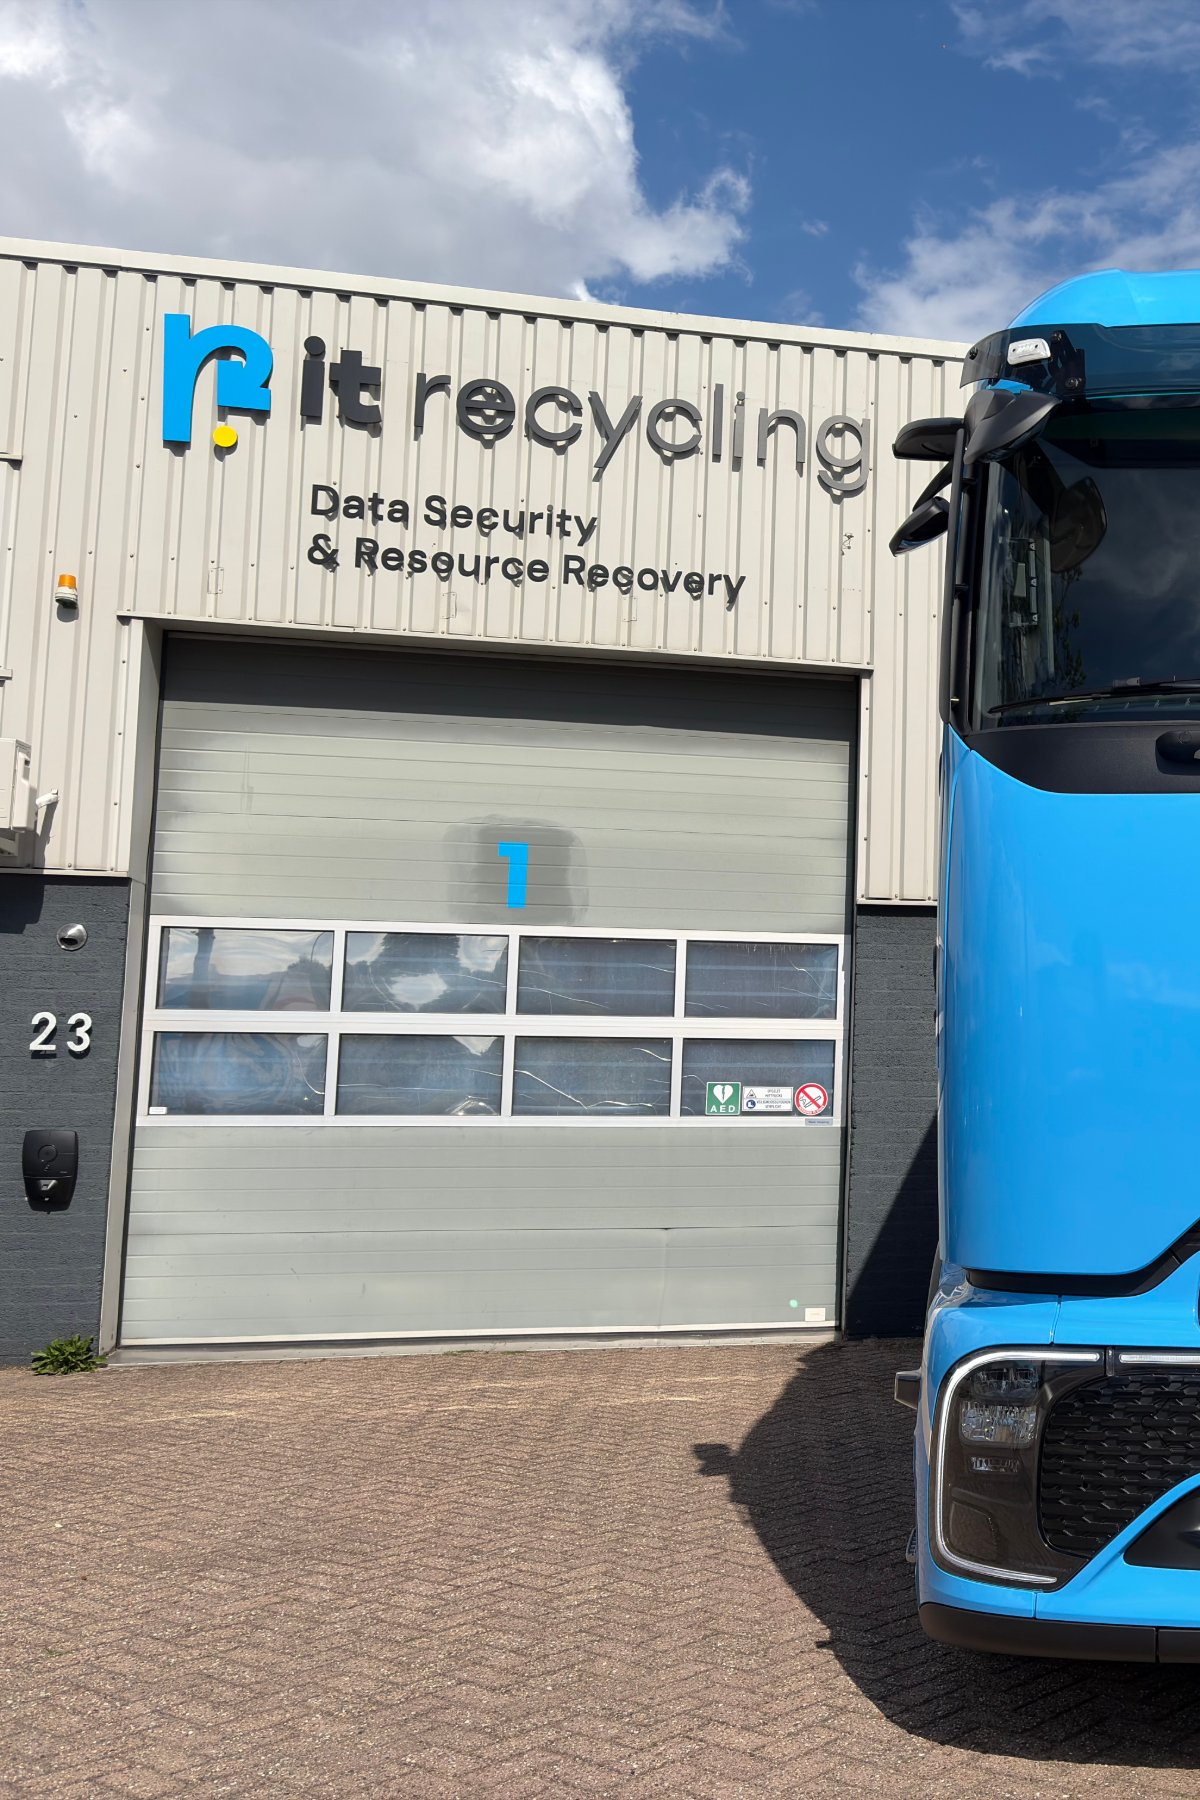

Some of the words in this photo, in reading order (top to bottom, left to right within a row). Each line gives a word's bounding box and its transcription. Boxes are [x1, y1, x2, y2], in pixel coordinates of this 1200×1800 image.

[300, 335, 382, 424] it
[414, 372, 872, 492] recycling
[310, 484, 410, 523] Data
[423, 494, 599, 547] Security
[307, 533, 341, 567] &
[354, 536, 550, 583] Resource
[562, 554, 747, 606] Recovery
[497, 842, 529, 908] 1
[29, 1011, 93, 1052] 23
[709, 1104, 736, 1113] AED
